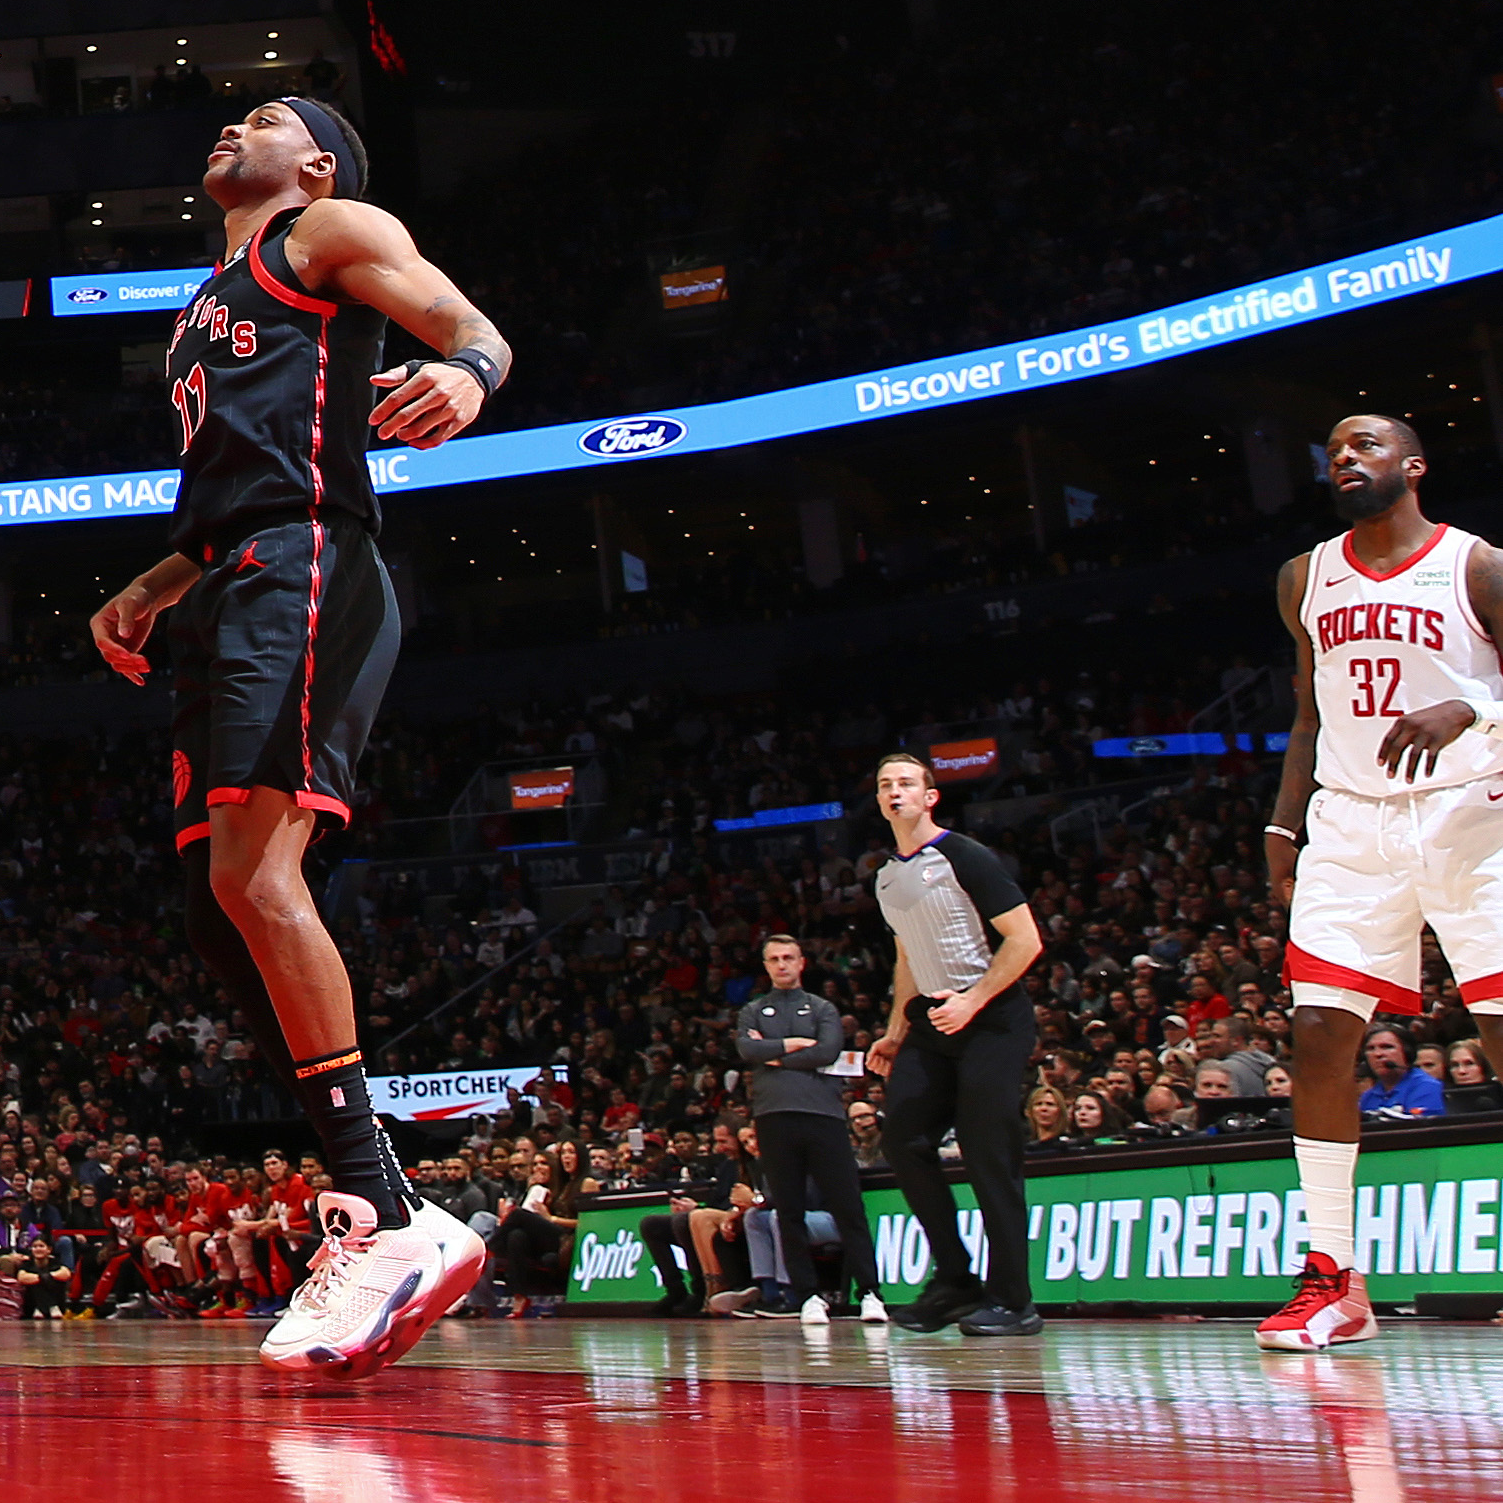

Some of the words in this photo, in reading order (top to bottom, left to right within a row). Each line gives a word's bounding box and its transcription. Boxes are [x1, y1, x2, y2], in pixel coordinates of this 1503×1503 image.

[118, 284, 180, 300] Discover
[854, 359, 1004, 412] Discover
[1016, 335, 1130, 382] Ford's
[1138, 277, 1318, 354] Electrified
[1326, 246, 1452, 304] Family
[172, 361, 207, 456] 11
[600, 421, 666, 453] Ford
[1413, 579, 1451, 587] karma
[1415, 571, 1451, 579] credit
[1317, 602, 1444, 654] ROCKETS
[1349, 658, 1405, 718] 32
[932, 753, 988, 771] Tangerine
[511, 781, 564, 799] Tangerine
[388, 1075, 510, 1099] SPORTCHEK
[1045, 1198, 1143, 1282] BUT
[573, 1228, 645, 1292] Sprite
